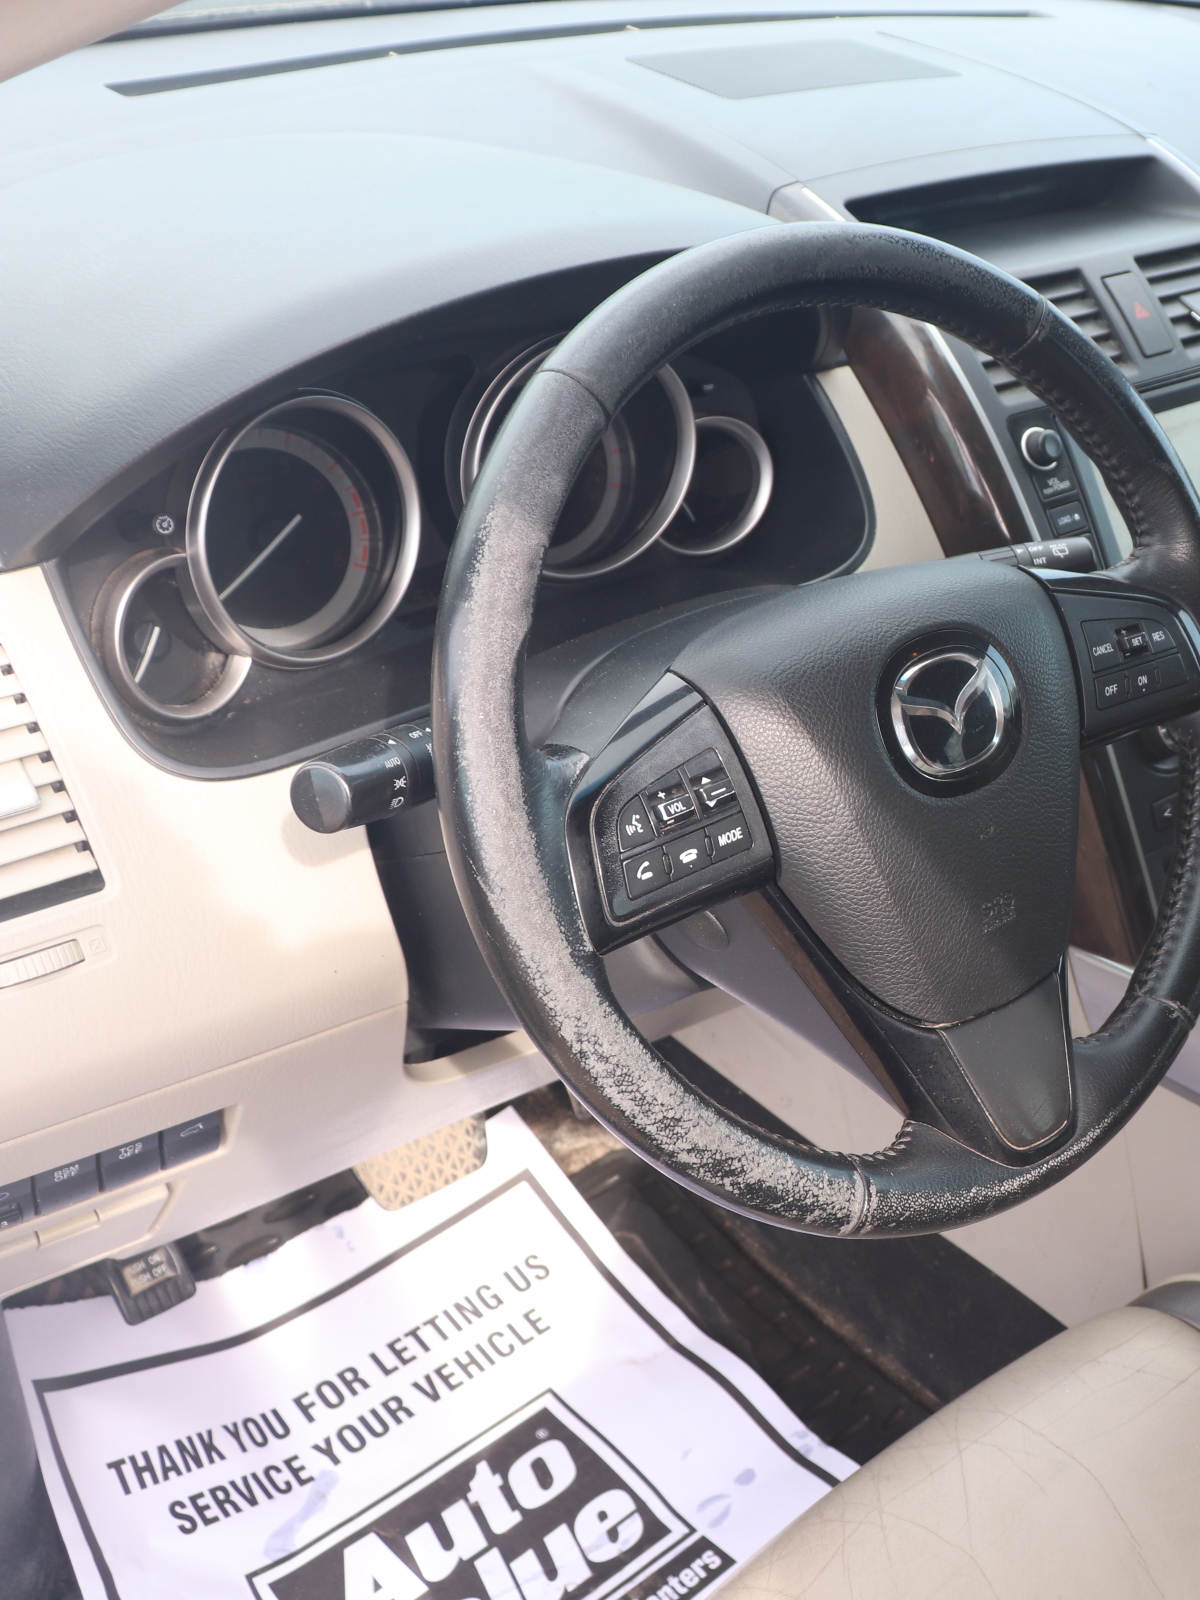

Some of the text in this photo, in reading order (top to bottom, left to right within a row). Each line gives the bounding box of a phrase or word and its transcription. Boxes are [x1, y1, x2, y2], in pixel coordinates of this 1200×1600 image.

[1033, 556, 1047, 566] INT
[1131, 636, 1143, 647] SET
[1152, 630, 1165, 642] RES
[1092, 643, 1114, 656] CANCEL
[1137, 675, 1148, 686] ON
[1104, 683, 1118, 696] OFF
[384, 756, 401, 769] AUTO
[666, 802, 687, 815] VOL
[717, 826, 744, 847] MODE
[118, 1142, 143, 1155] TCS
[118, 1147, 142, 1160] OFF
[54, 1164, 79, 1178] BSM
[54, 1170, 78, 1182] OFF
[147, 1253, 161, 1266] ON
[152, 1262, 167, 1277] OFF
[106, 1254, 551, 1496] THANK YOU FOR LETTING US
[168, 1308, 552, 1536] SERVICE YOUR VEHICLE
[342, 1438, 578, 1600] Auto
[460, 1488, 645, 1600] lue
